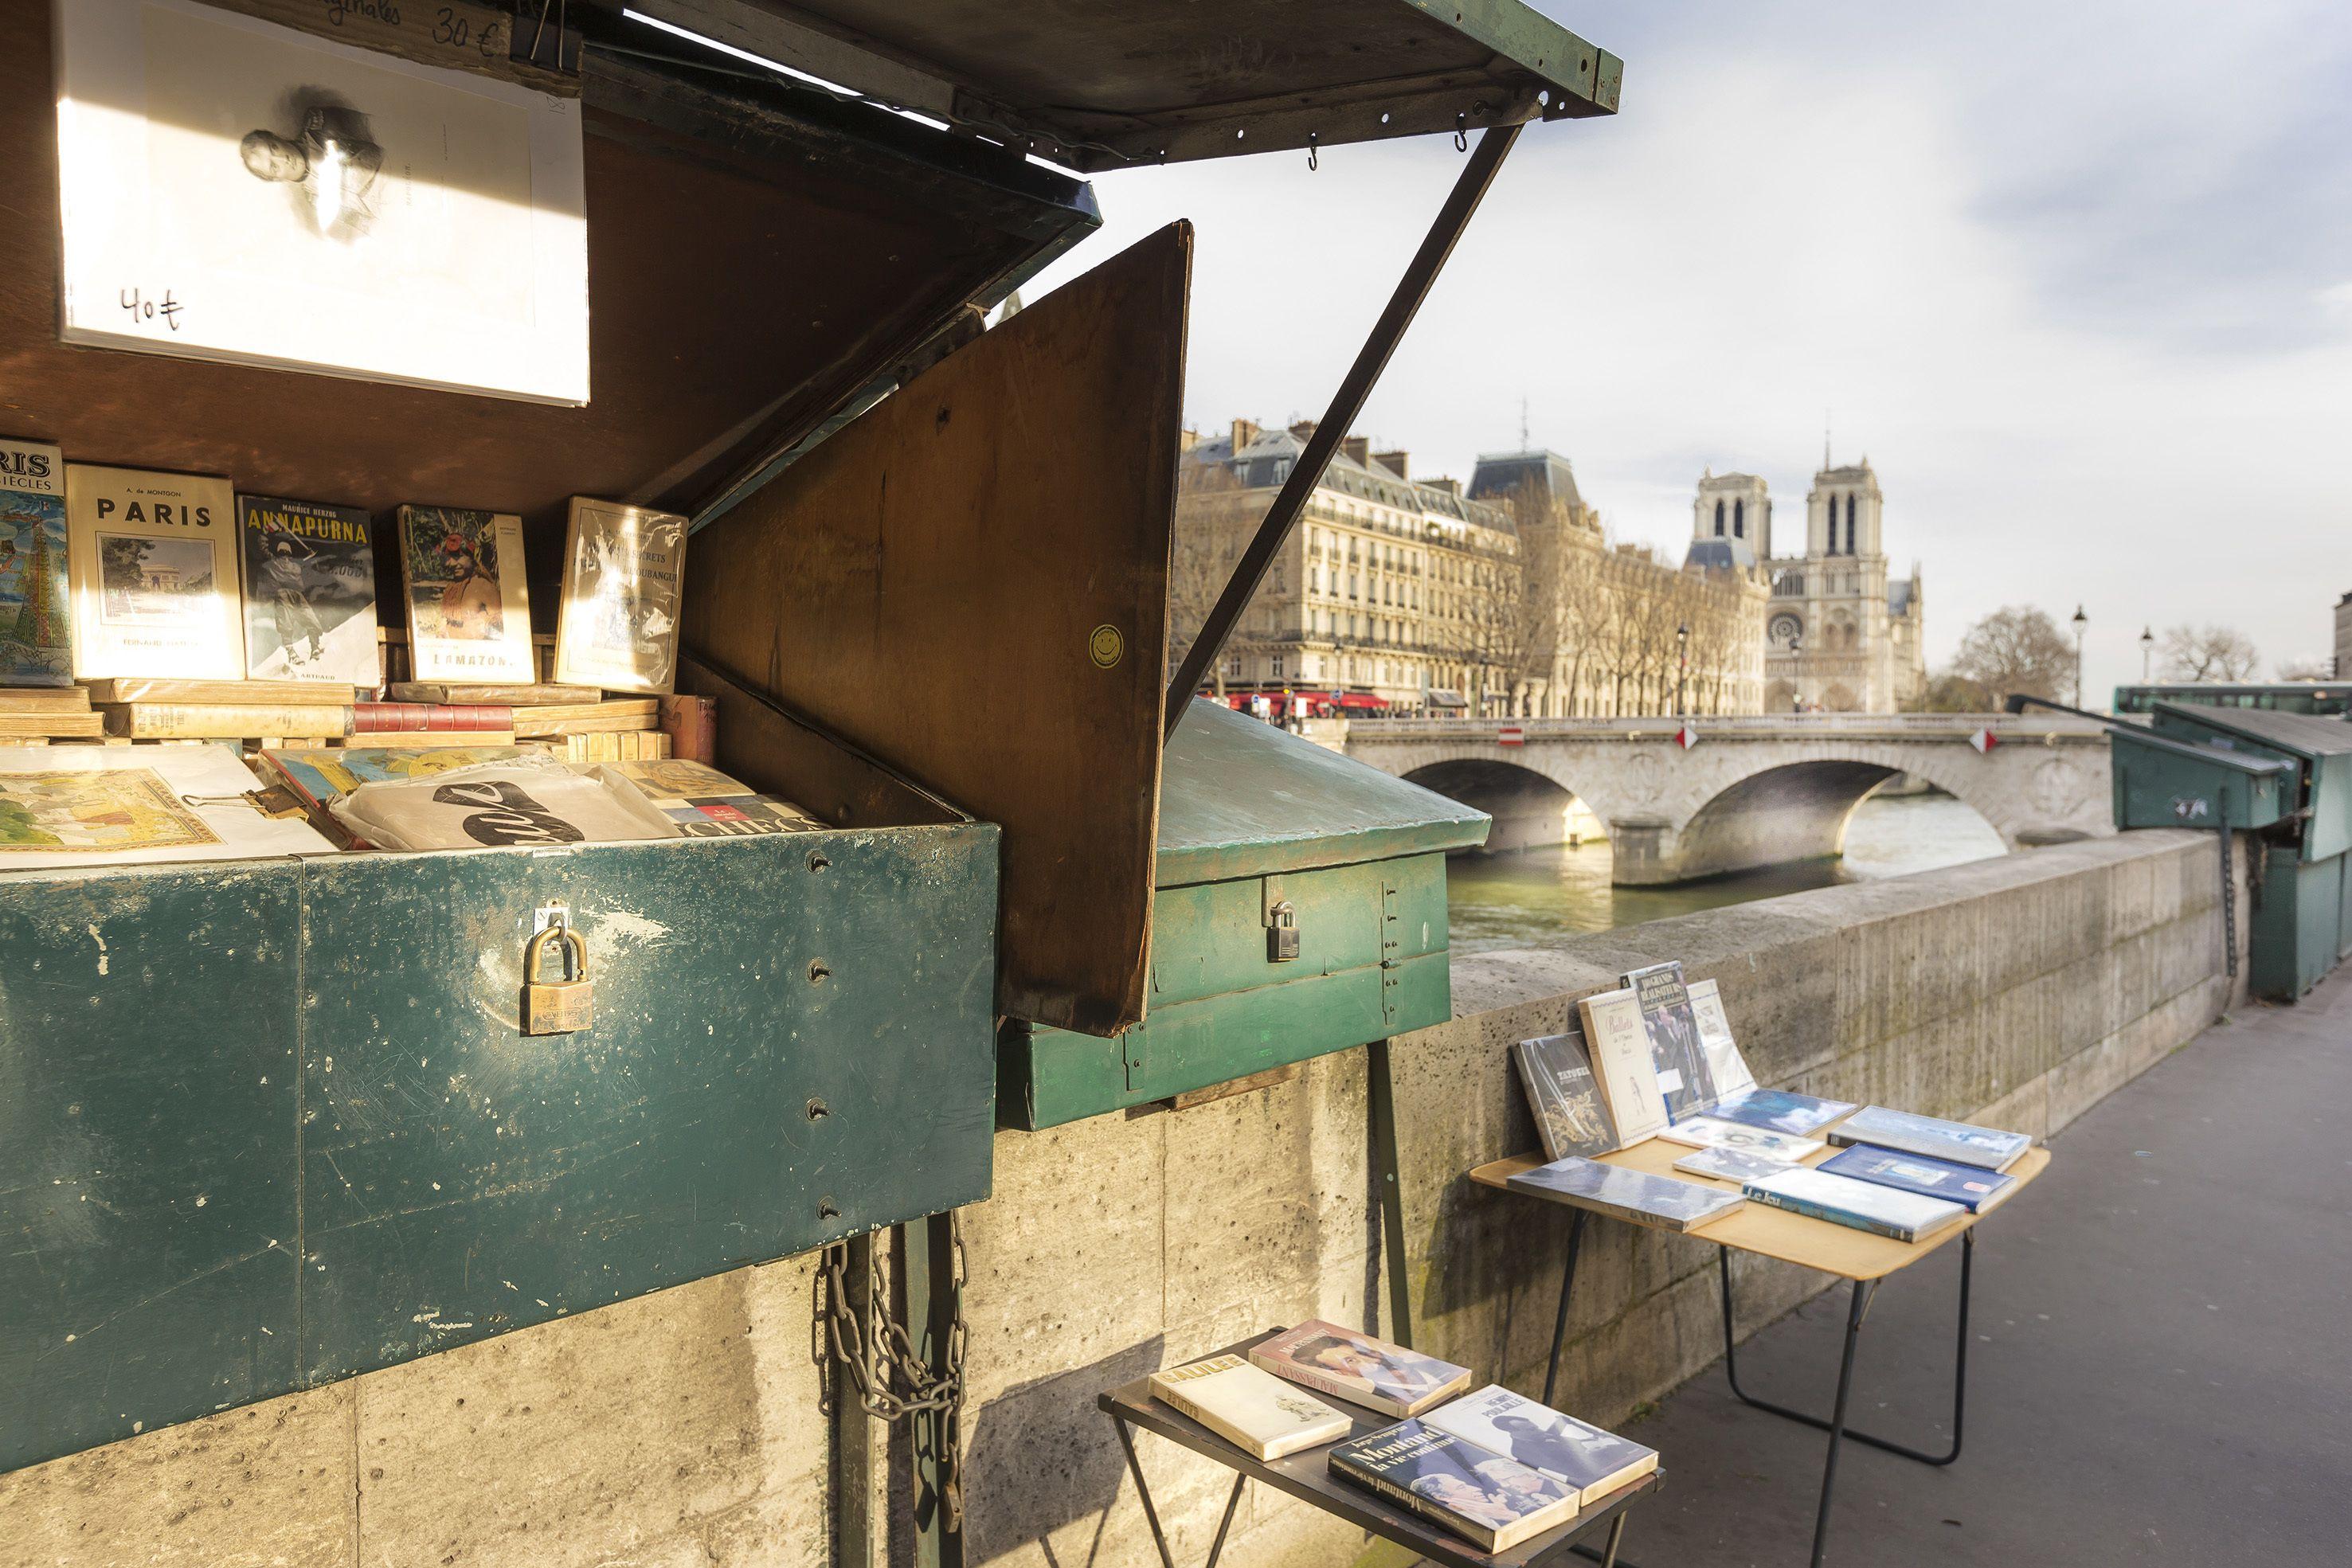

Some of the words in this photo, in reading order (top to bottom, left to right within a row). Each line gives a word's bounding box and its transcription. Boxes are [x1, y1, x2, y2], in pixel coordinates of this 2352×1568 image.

[323, 0, 401, 26] ginales
[0, 476, 52, 491] IECLES
[96, 498, 211, 527] PARIS
[281, 503, 311, 515] MAURICE
[313, 508, 337, 518] HERZOG
[248, 508, 368, 545] ANNAPURNA
[677, 817, 834, 837] CHECS
[1276, 1363, 1339, 1395] MAUPASSANT
[1348, 1425, 1445, 1465] Montand
[1368, 1460, 1387, 1472] la
[1389, 1452, 1408, 1466] vie
[1376, 1478, 1423, 1512] Montand
